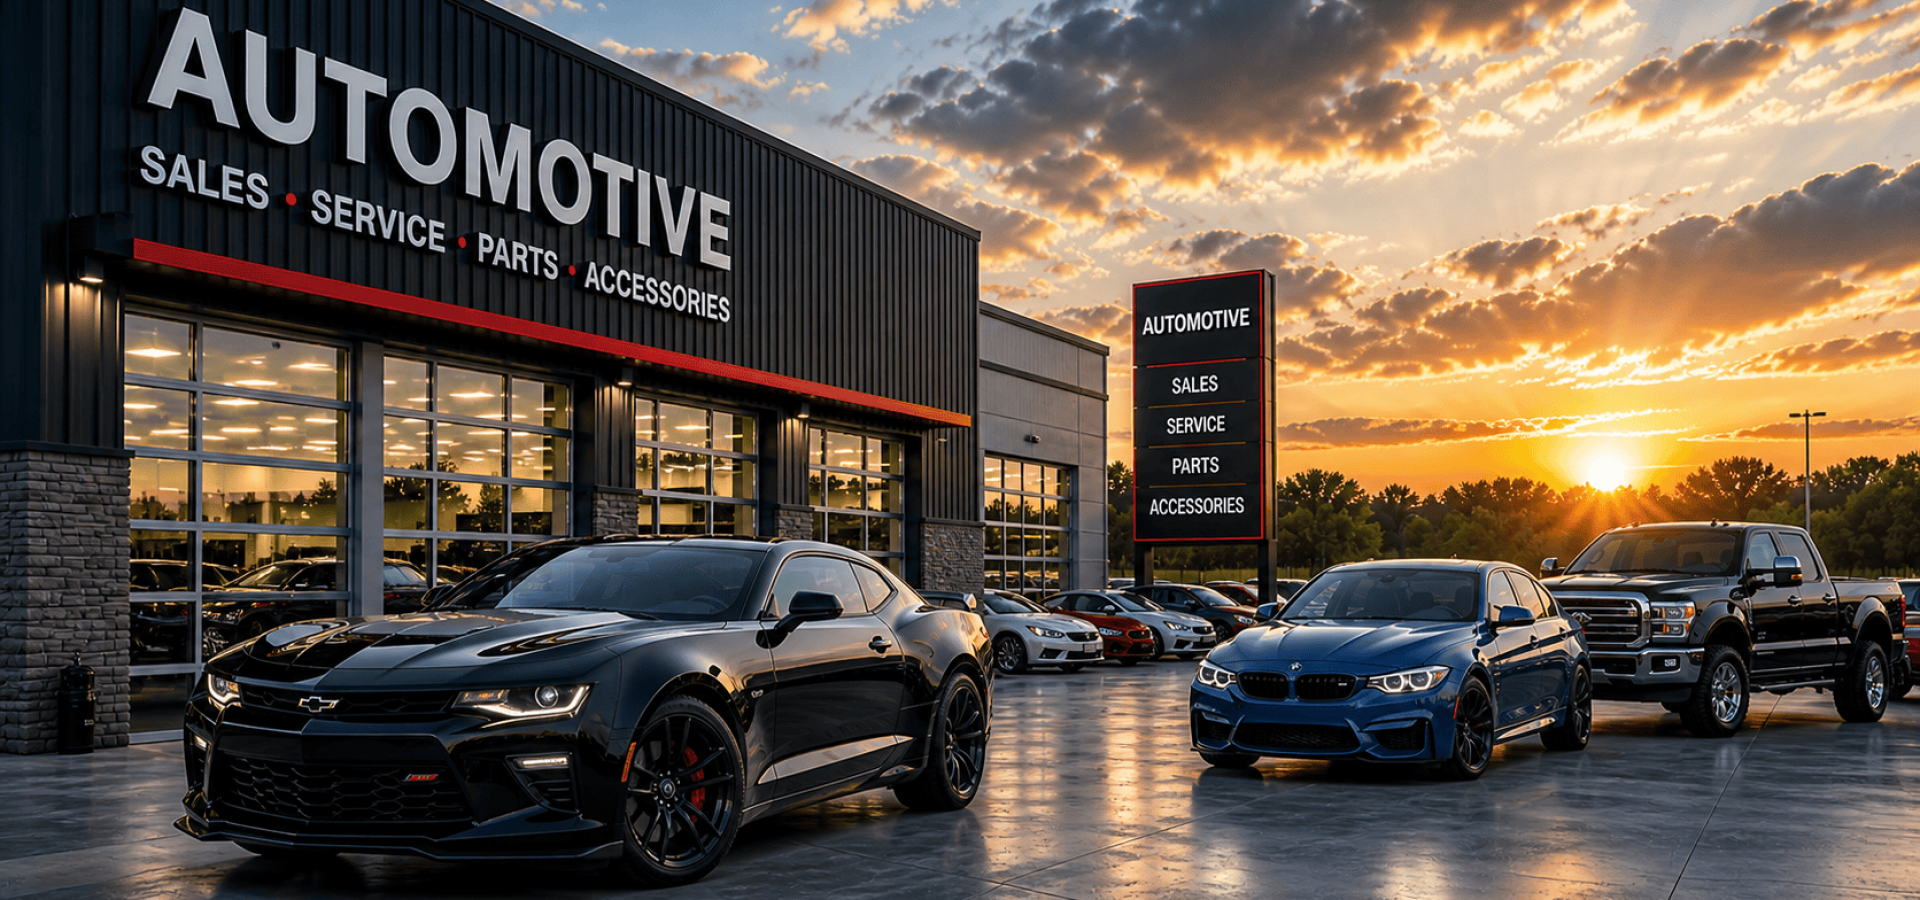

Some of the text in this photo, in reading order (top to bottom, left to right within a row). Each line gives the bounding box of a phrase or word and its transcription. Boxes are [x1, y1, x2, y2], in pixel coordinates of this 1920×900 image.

[146, 7, 731, 271] AUTOMOTIVE
[140, 145, 731, 323] SALES SERVICE PARTS ACCESSORIES
[1141, 307, 1251, 336] AUTOMOTIVE
[1171, 374, 1219, 395] SALES
[1166, 414, 1226, 435] SERVICE
[1171, 456, 1220, 475] PARTS
[1149, 496, 1245, 516] ACCESSORIES
